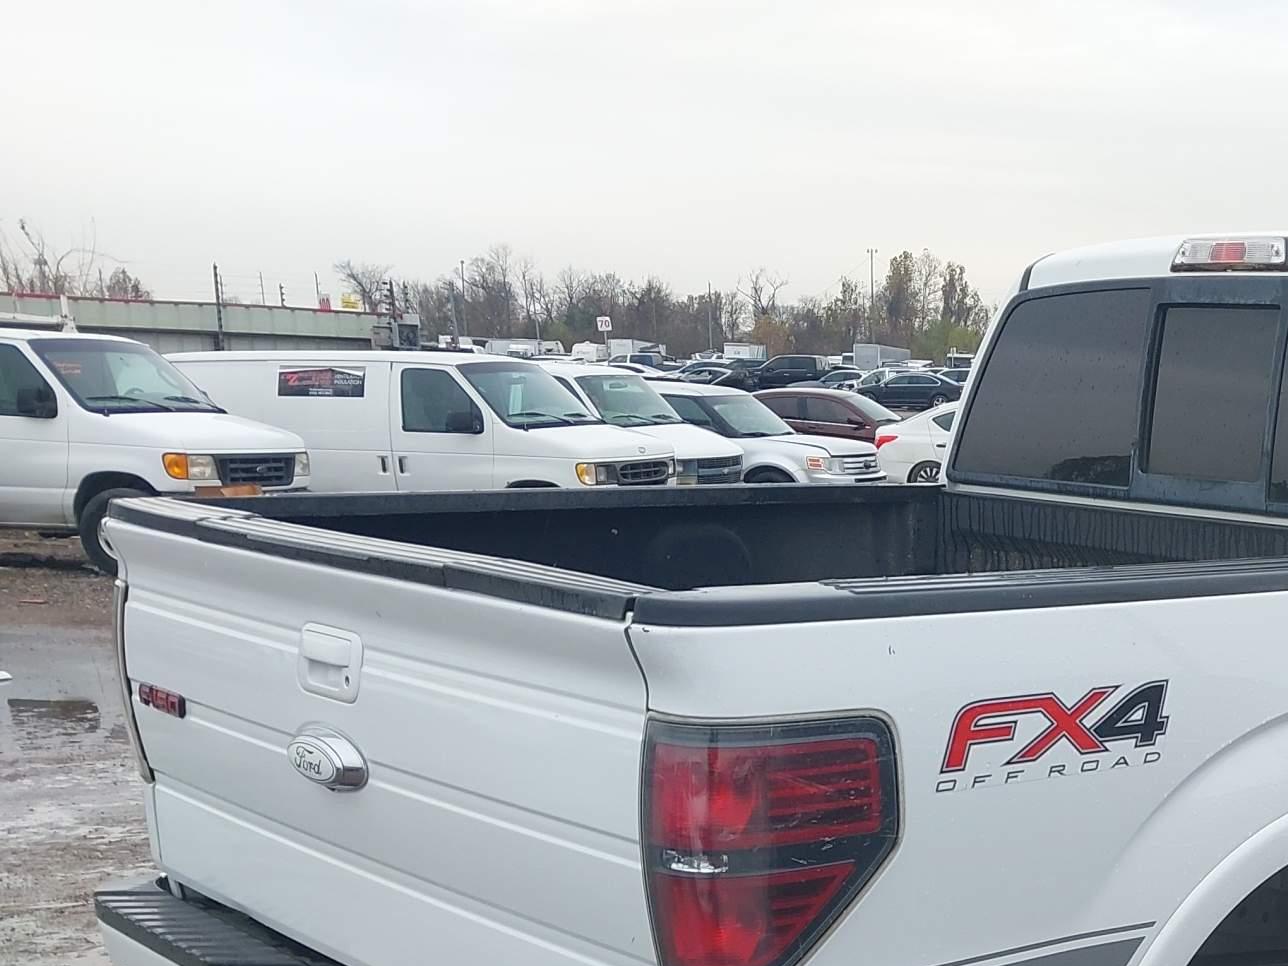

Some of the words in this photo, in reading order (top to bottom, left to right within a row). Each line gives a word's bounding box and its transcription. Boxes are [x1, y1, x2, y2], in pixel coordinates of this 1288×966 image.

[598, 319, 610, 329] 70
[940, 679, 1169, 774] FX4
[294, 745, 322, 776] Ford
[935, 769, 1025, 793] OFF
[1047, 752, 1161, 778] ROAD
